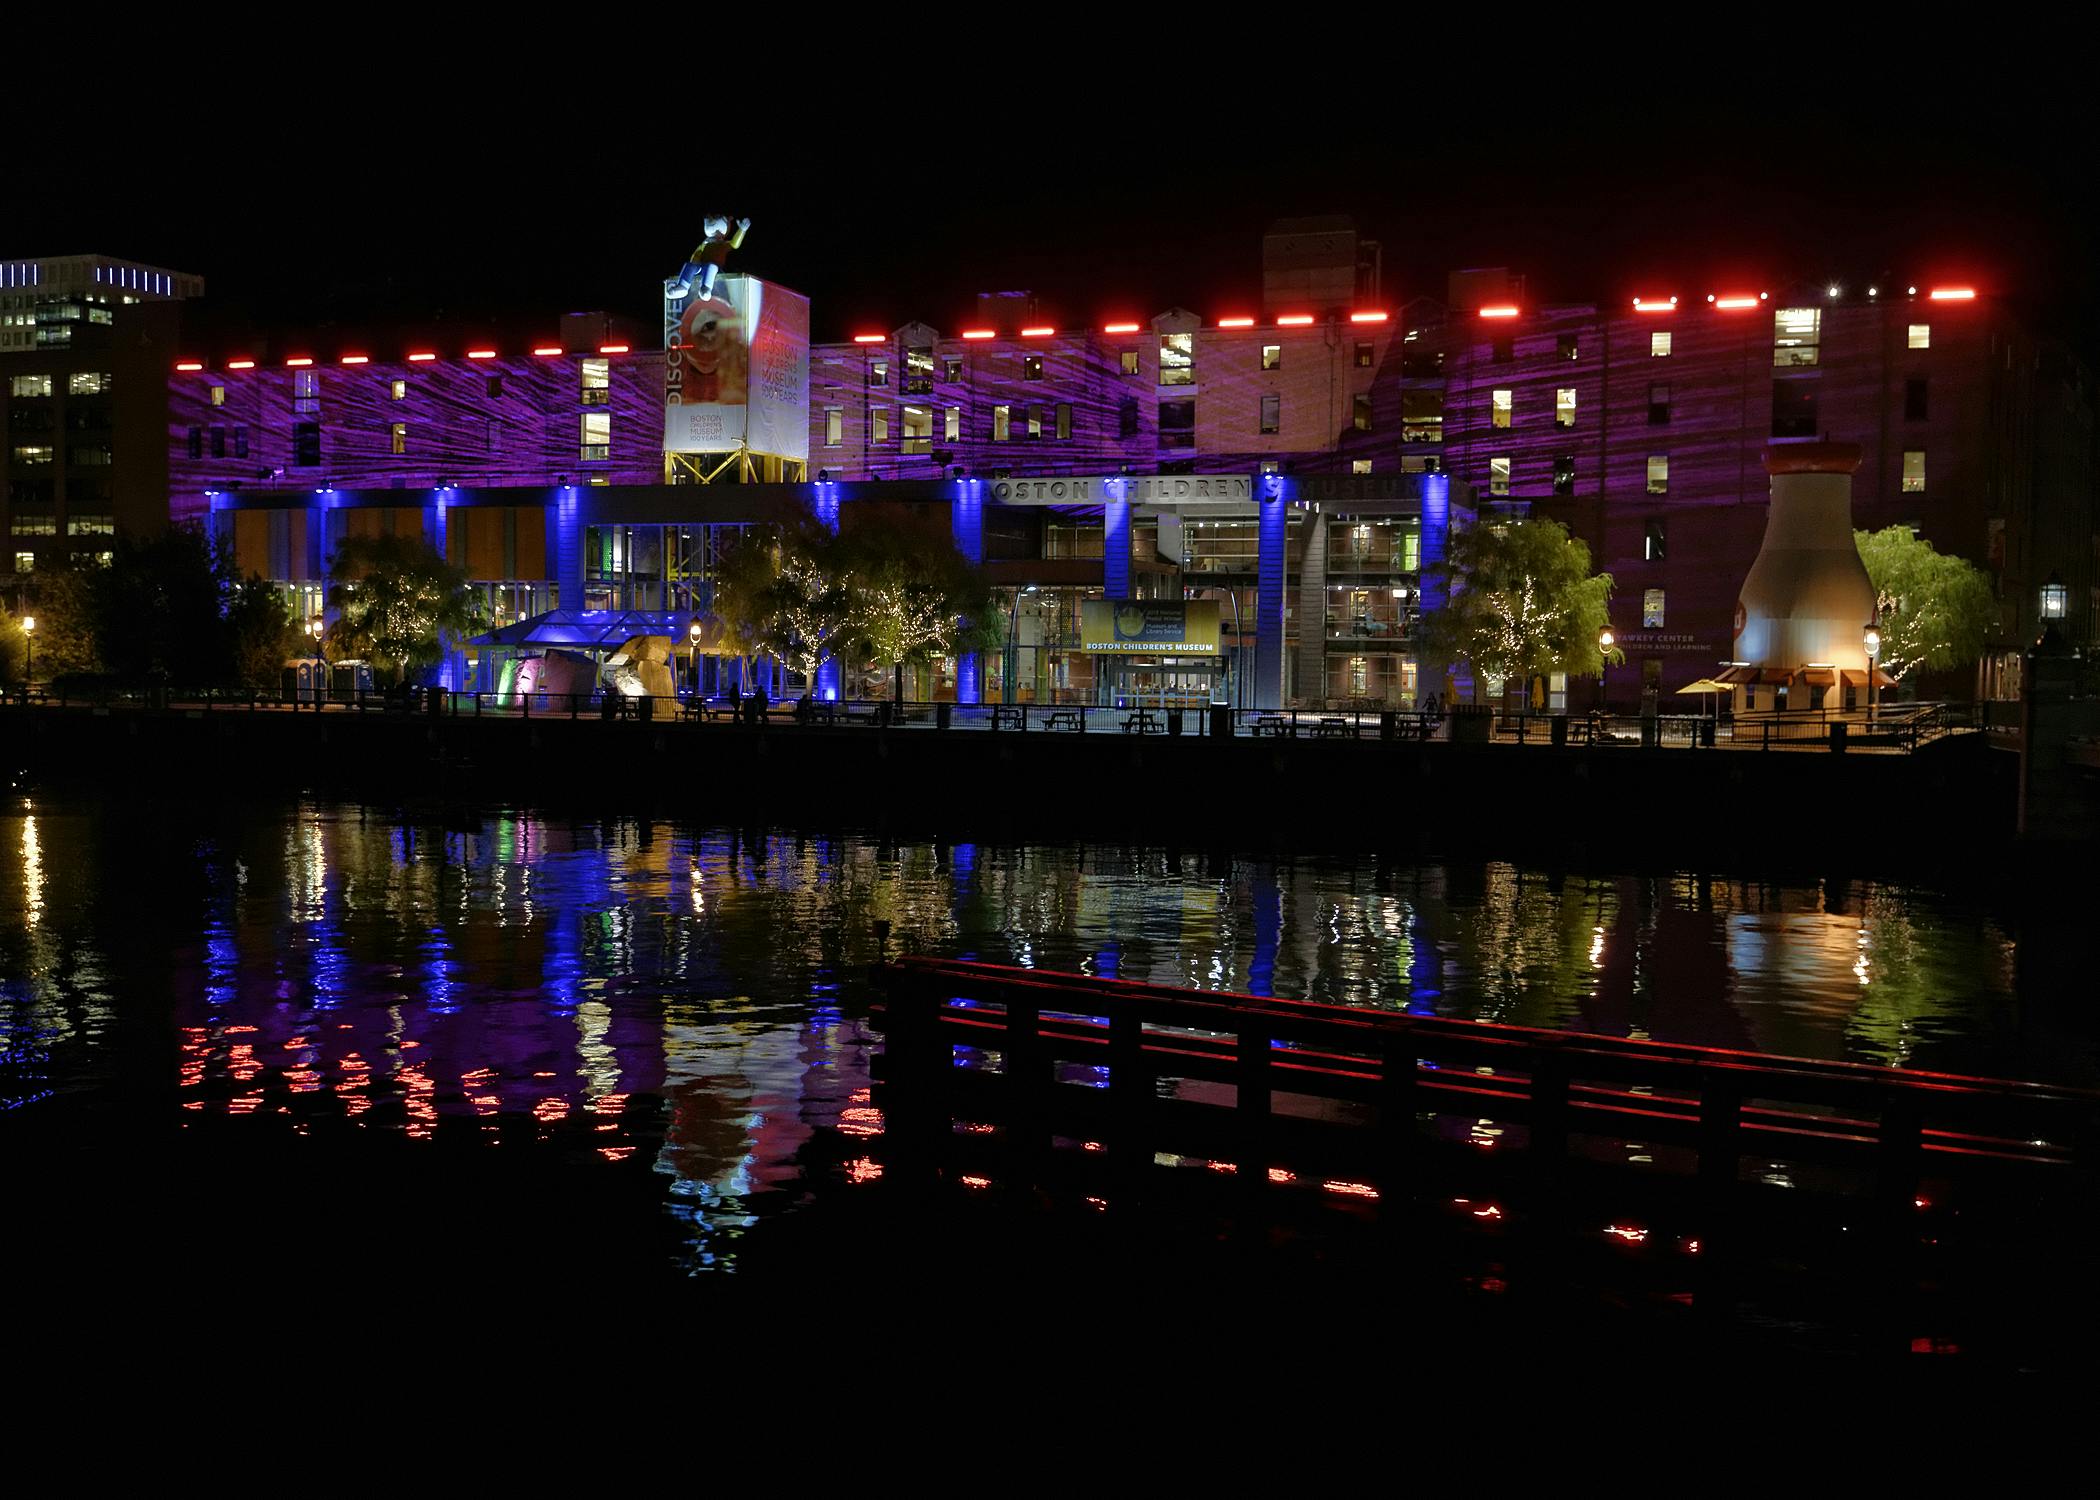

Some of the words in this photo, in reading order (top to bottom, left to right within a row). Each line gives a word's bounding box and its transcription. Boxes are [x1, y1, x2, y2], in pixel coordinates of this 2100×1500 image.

[666, 282, 683, 406] DISCOVE
[1657, 635, 1694, 643] CENTER
[1122, 643, 1173, 651] CHILDREN'S
